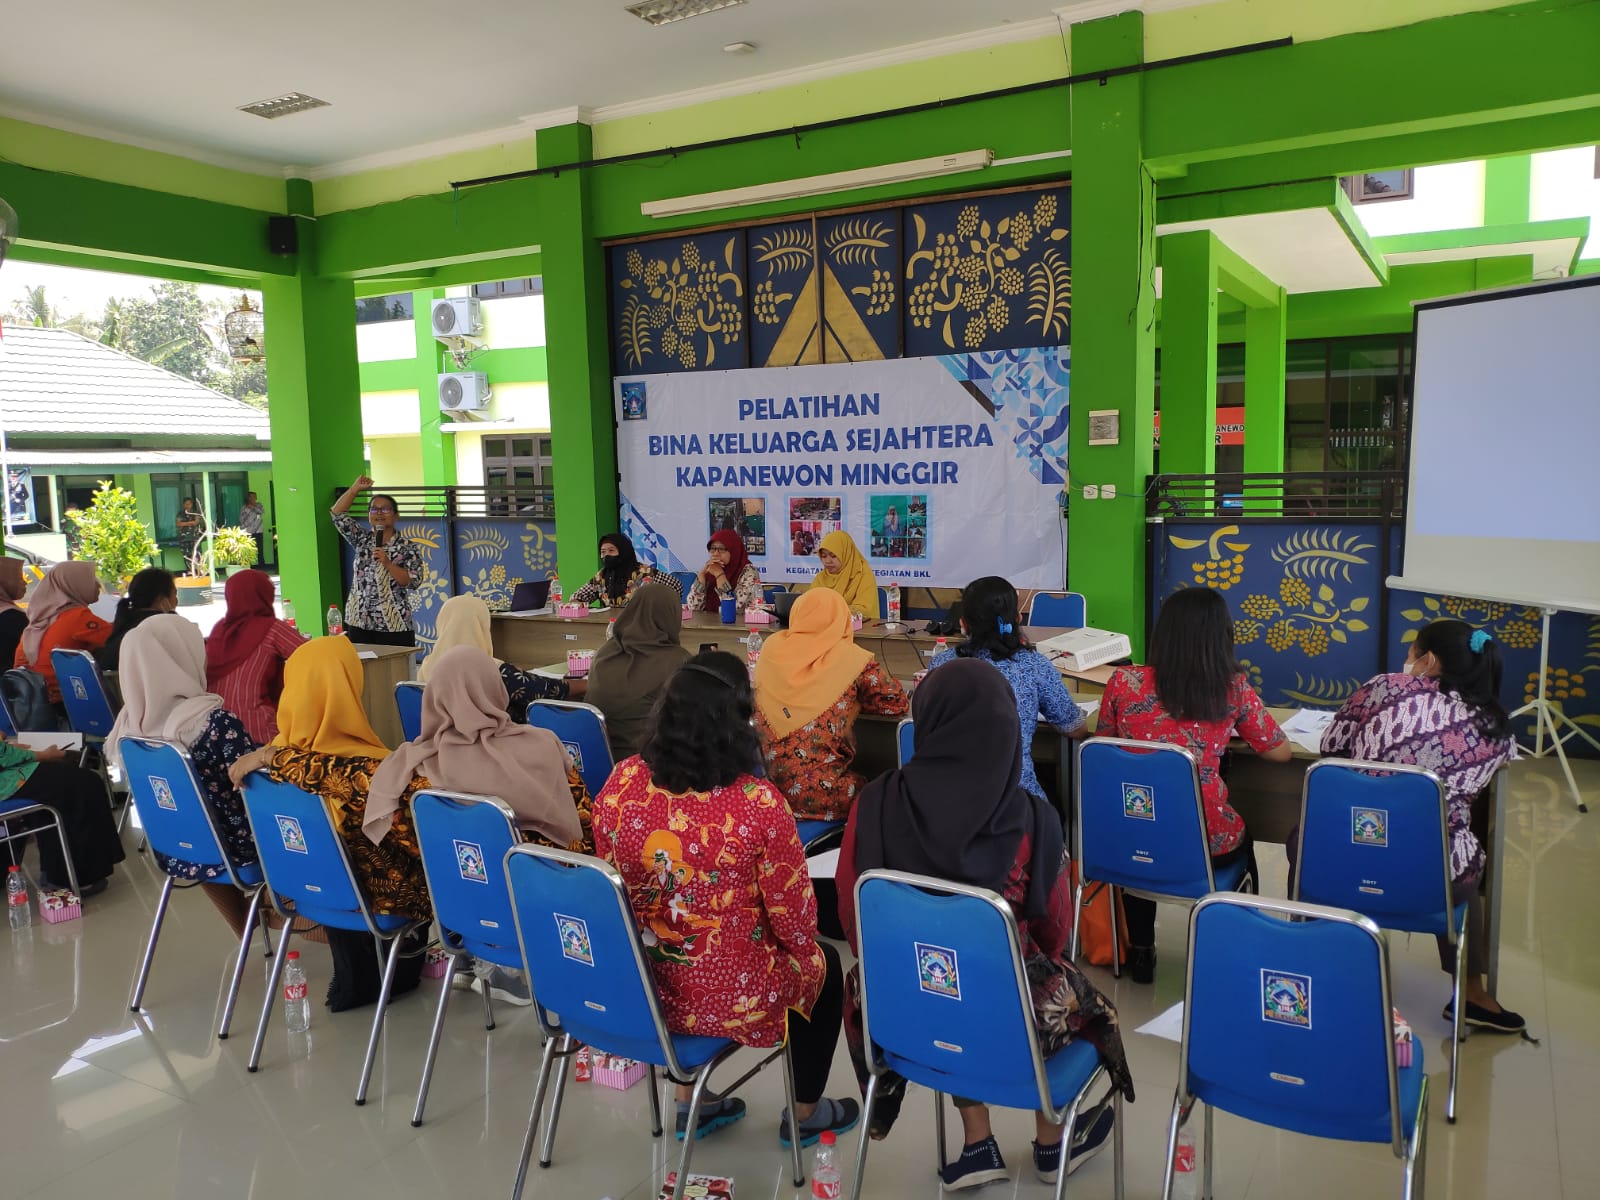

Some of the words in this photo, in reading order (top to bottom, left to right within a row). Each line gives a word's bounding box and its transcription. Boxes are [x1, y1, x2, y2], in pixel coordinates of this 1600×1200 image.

[738, 393, 880, 420] PELATIHAN
[648, 433, 704, 456] BINA
[709, 429, 839, 454] KELUARGA
[846, 423, 994, 453] SEJAHTERA
[676, 464, 833, 487] KAPANEWON
[841, 461, 959, 486] MINGGIR
[786, 567, 823, 575] KEGIATA
[913, 570, 931, 578] BKL
